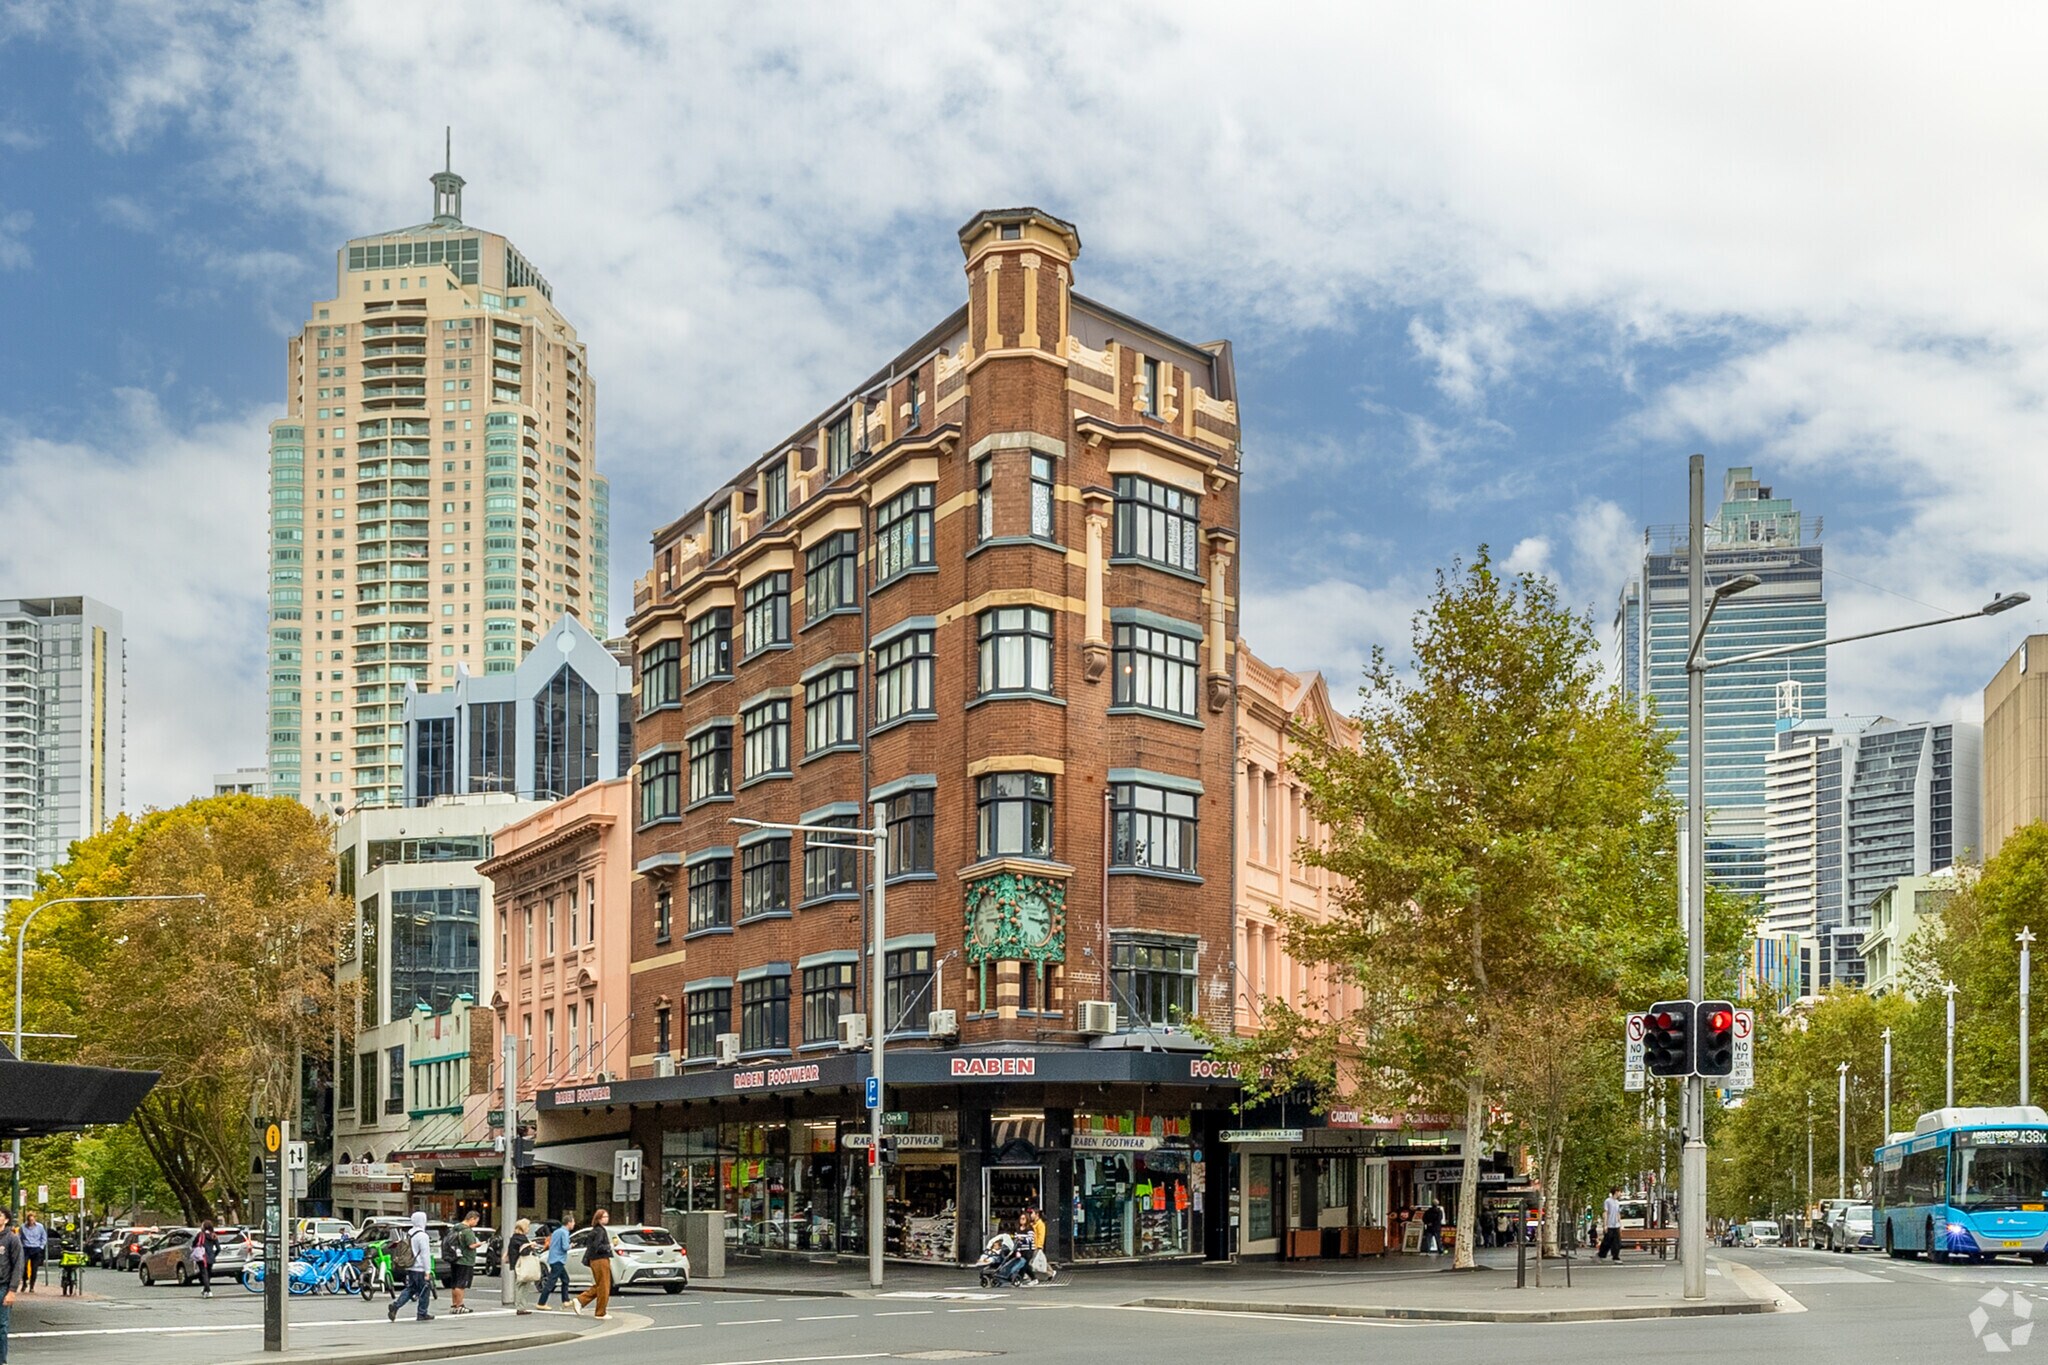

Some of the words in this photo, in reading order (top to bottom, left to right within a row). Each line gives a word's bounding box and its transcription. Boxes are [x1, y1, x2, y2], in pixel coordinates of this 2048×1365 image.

[1631, 1043, 1642, 1053] NO
[1735, 1042, 1748, 1051] NO
[951, 1058, 1035, 1076] RABEN
[734, 1070, 764, 1089] RABEN
[768, 1064, 820, 1086] FOOTWEAR
[870, 1081, 876, 1092] P
[555, 1090, 575, 1105] RABEN
[577, 1086, 611, 1103] FOOTWEAR
[1331, 1110, 1358, 1123] CARLTON
[1073, 1137, 1098, 1147] RABEN
[1101, 1138, 1145, 1148] FOOTWEAR
